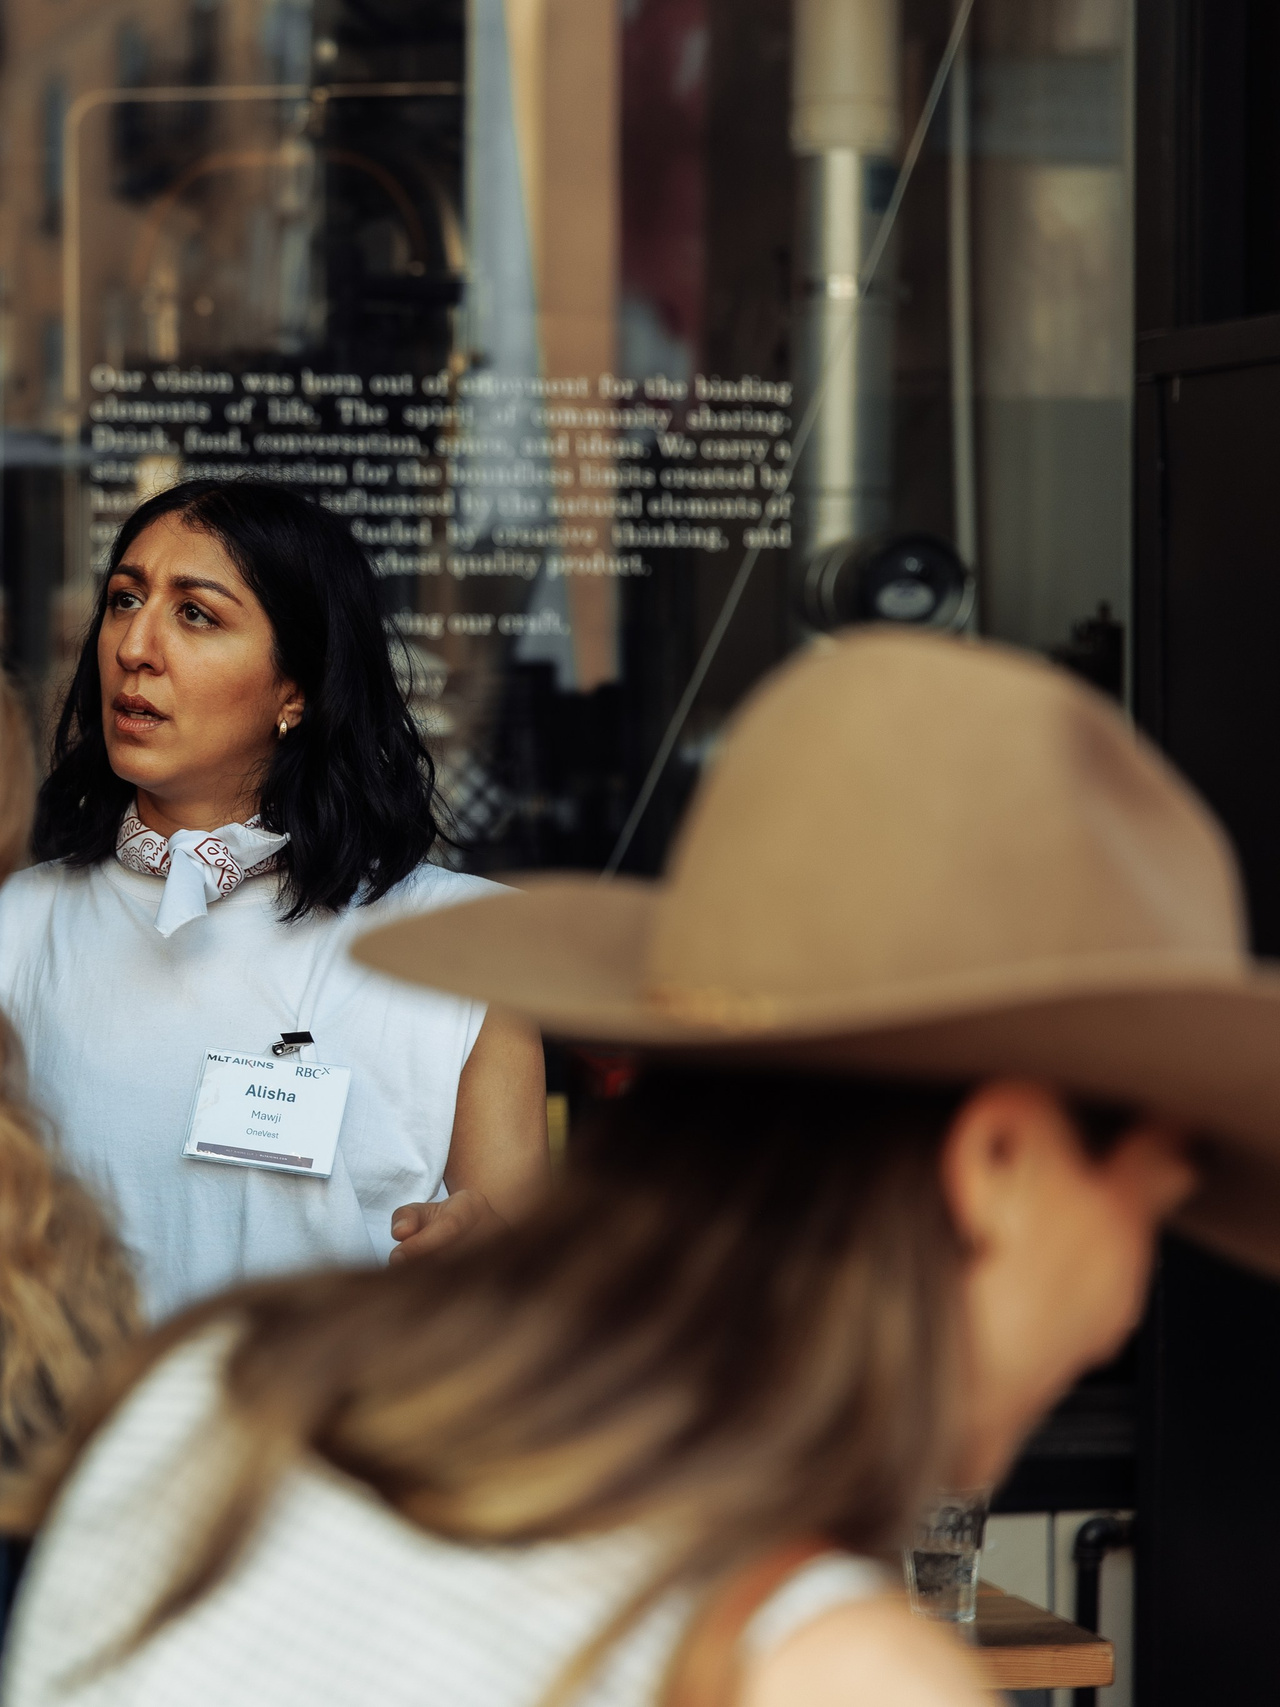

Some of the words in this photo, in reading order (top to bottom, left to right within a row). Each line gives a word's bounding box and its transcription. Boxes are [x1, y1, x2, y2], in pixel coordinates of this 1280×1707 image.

[90, 364, 146, 392] Our
[152, 366, 233, 394] vision
[241, 372, 294, 395] was
[301, 368, 362, 396] born
[370, 375, 413, 396] out
[422, 369, 451, 396] of
[599, 372, 638, 400] for
[645, 374, 688, 401] the
[696, 374, 793, 407] binding
[90, 394, 212, 424] elements
[224, 397, 257, 424] of
[335, 397, 389, 426] The
[402, 398, 474, 431] spirit
[530, 403, 673, 437] community
[520, 432, 569, 458] and
[657, 432, 697, 460] We
[701, 438, 769, 464] carry
[774, 439, 792, 461] a
[353, 457, 394, 486] for
[397, 458, 442, 486] the
[580, 459, 656, 488] limits
[660, 462, 755, 490] created
[760, 462, 793, 494] by
[498, 488, 541, 517] the
[547, 491, 642, 518] natural
[648, 491, 761, 519] elements
[765, 492, 794, 519] of
[446, 517, 478, 550] by
[492, 520, 597, 548] creative
[743, 521, 791, 549] and
[447, 547, 539, 580] quality
[447, 613, 496, 636] our
[207, 1053, 231, 1063] MLT
[232, 1057, 274, 1070] AIKINS
[245, 1084, 296, 1103] Alisha
[251, 1110, 282, 1124] Mawji
[246, 1128, 279, 1139] OneVest
